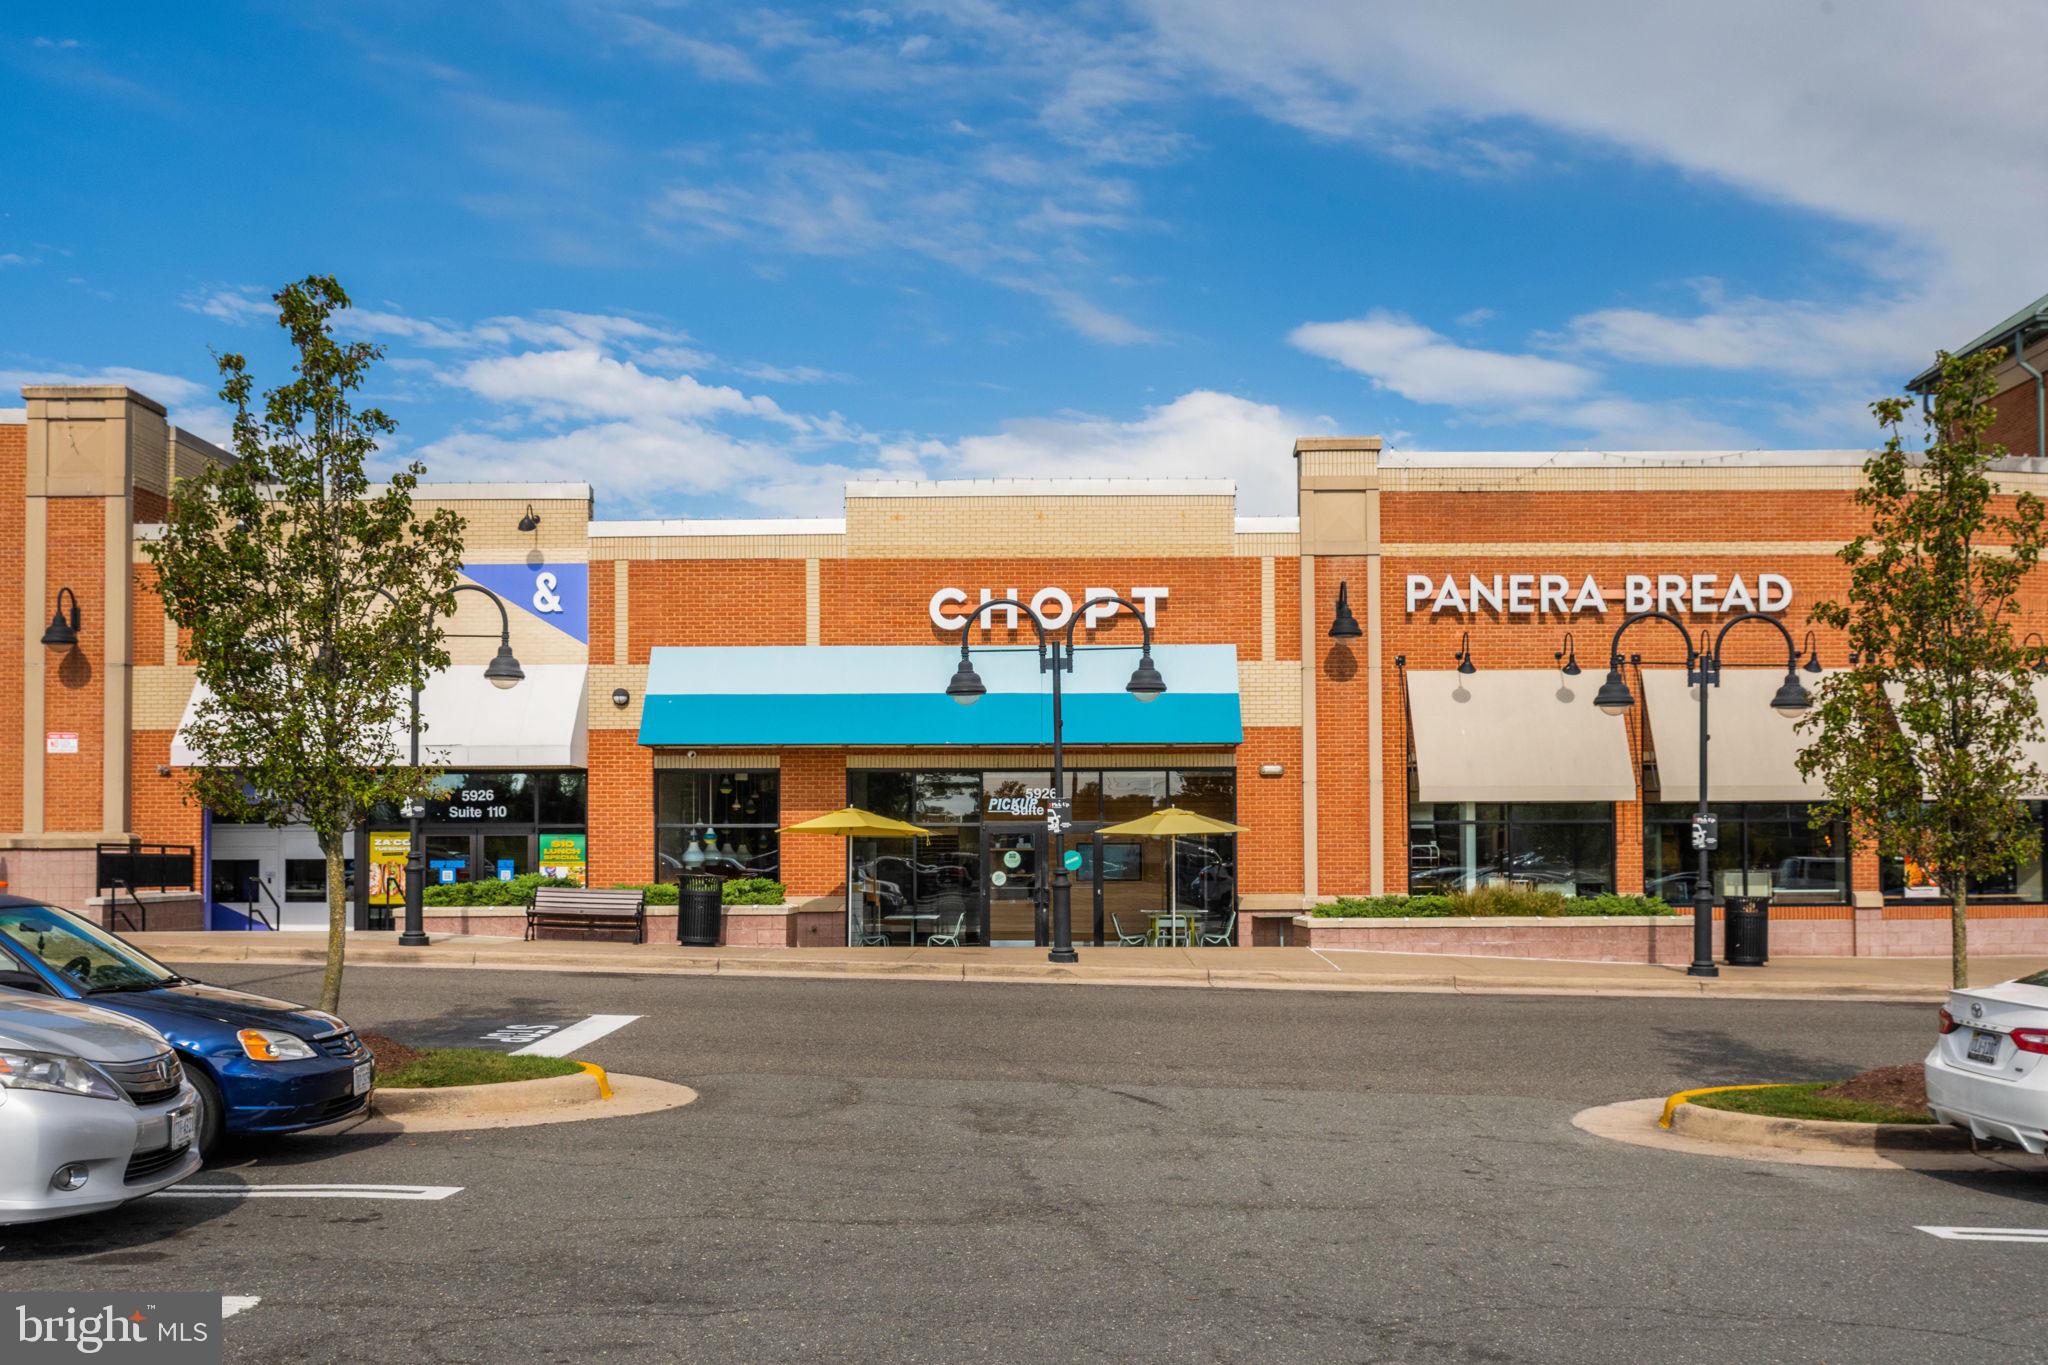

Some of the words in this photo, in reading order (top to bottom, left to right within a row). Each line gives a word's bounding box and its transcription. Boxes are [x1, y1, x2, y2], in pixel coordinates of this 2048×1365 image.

[533, 572, 563, 613] &
[1406, 574, 1608, 613] PANERA
[1625, 574, 1793, 613] BREAD
[929, 587, 1169, 630] CHOPT
[461, 789, 495, 801] 5926
[1025, 788, 1056, 799] 5926
[449, 805, 483, 818] Suite
[486, 805, 508, 818] 110
[988, 798, 1039, 812] PICKUP
[1011, 802, 1045, 816] Suite
